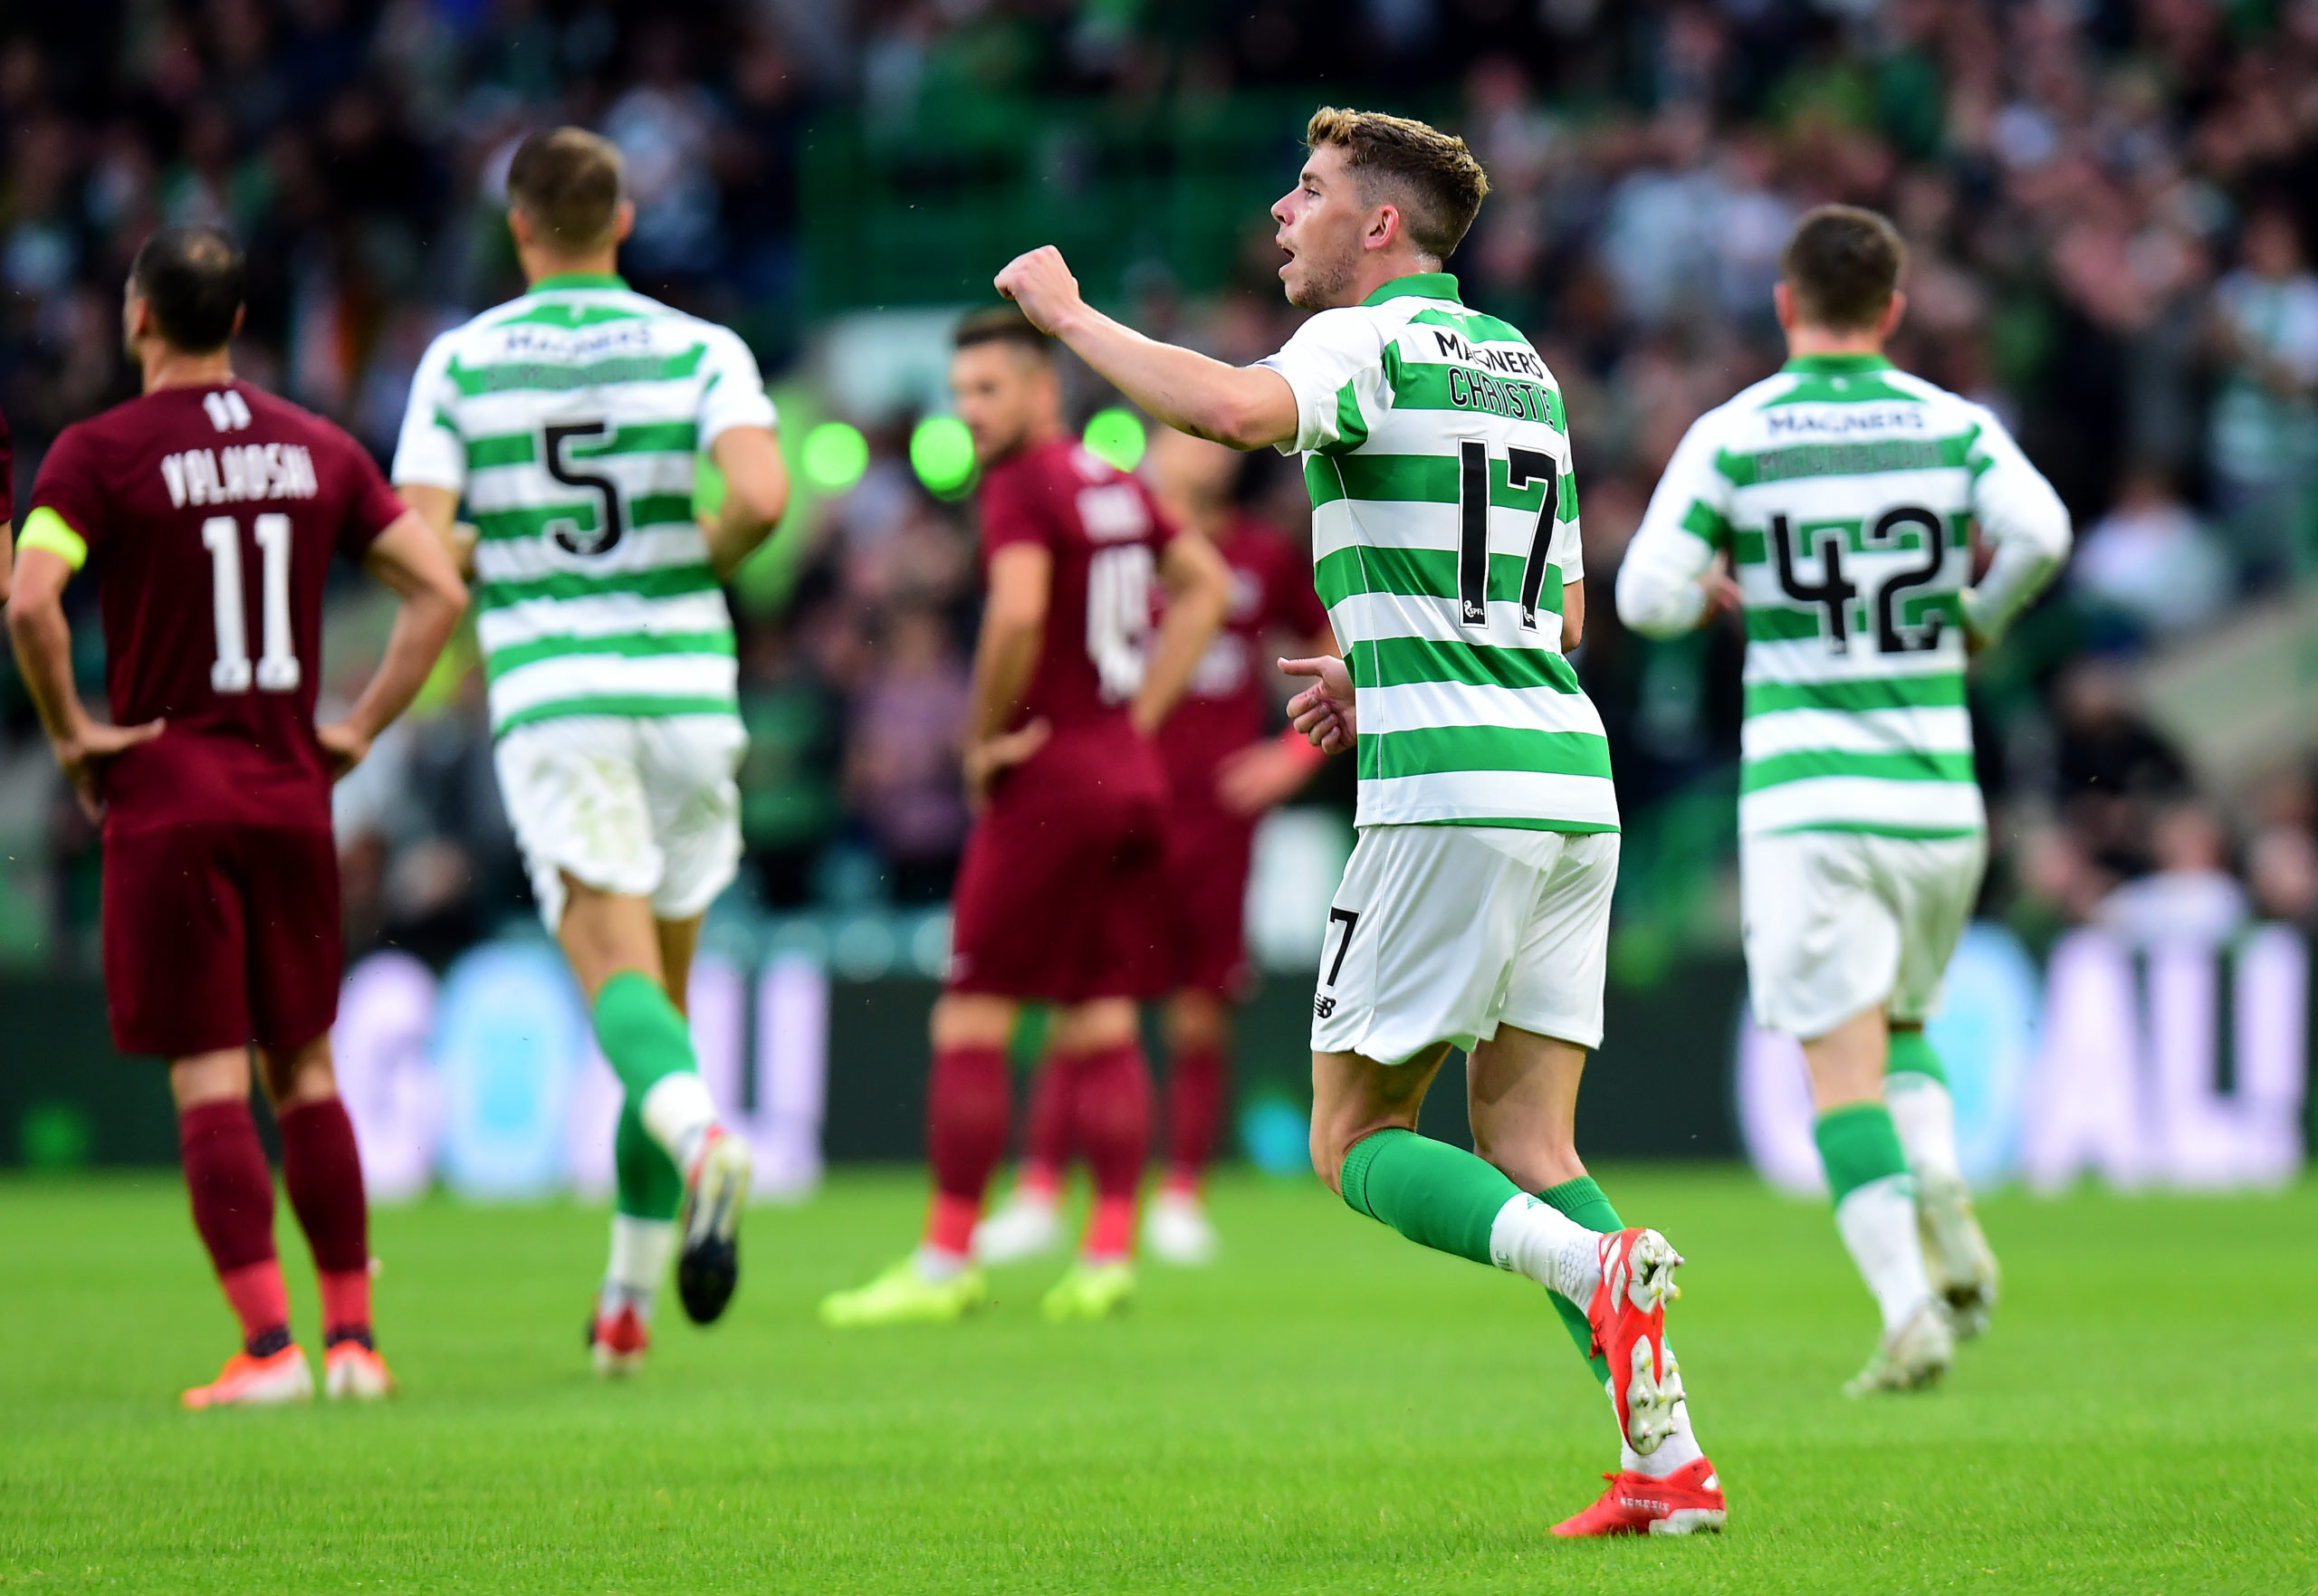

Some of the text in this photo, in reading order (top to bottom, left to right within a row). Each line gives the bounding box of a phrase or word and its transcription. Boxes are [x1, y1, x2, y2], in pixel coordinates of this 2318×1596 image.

[1432, 330, 1544, 380] MAGNERS
[1448, 366, 1555, 428] CHRISTIE
[543, 421, 625, 557] 5
[1458, 437, 1560, 634] 17
[201, 512, 302, 695] 11
[1770, 506, 1944, 655] 42
[1327, 906, 1361, 988] 7
[1620, 1496, 1671, 1513] NEMESIS
